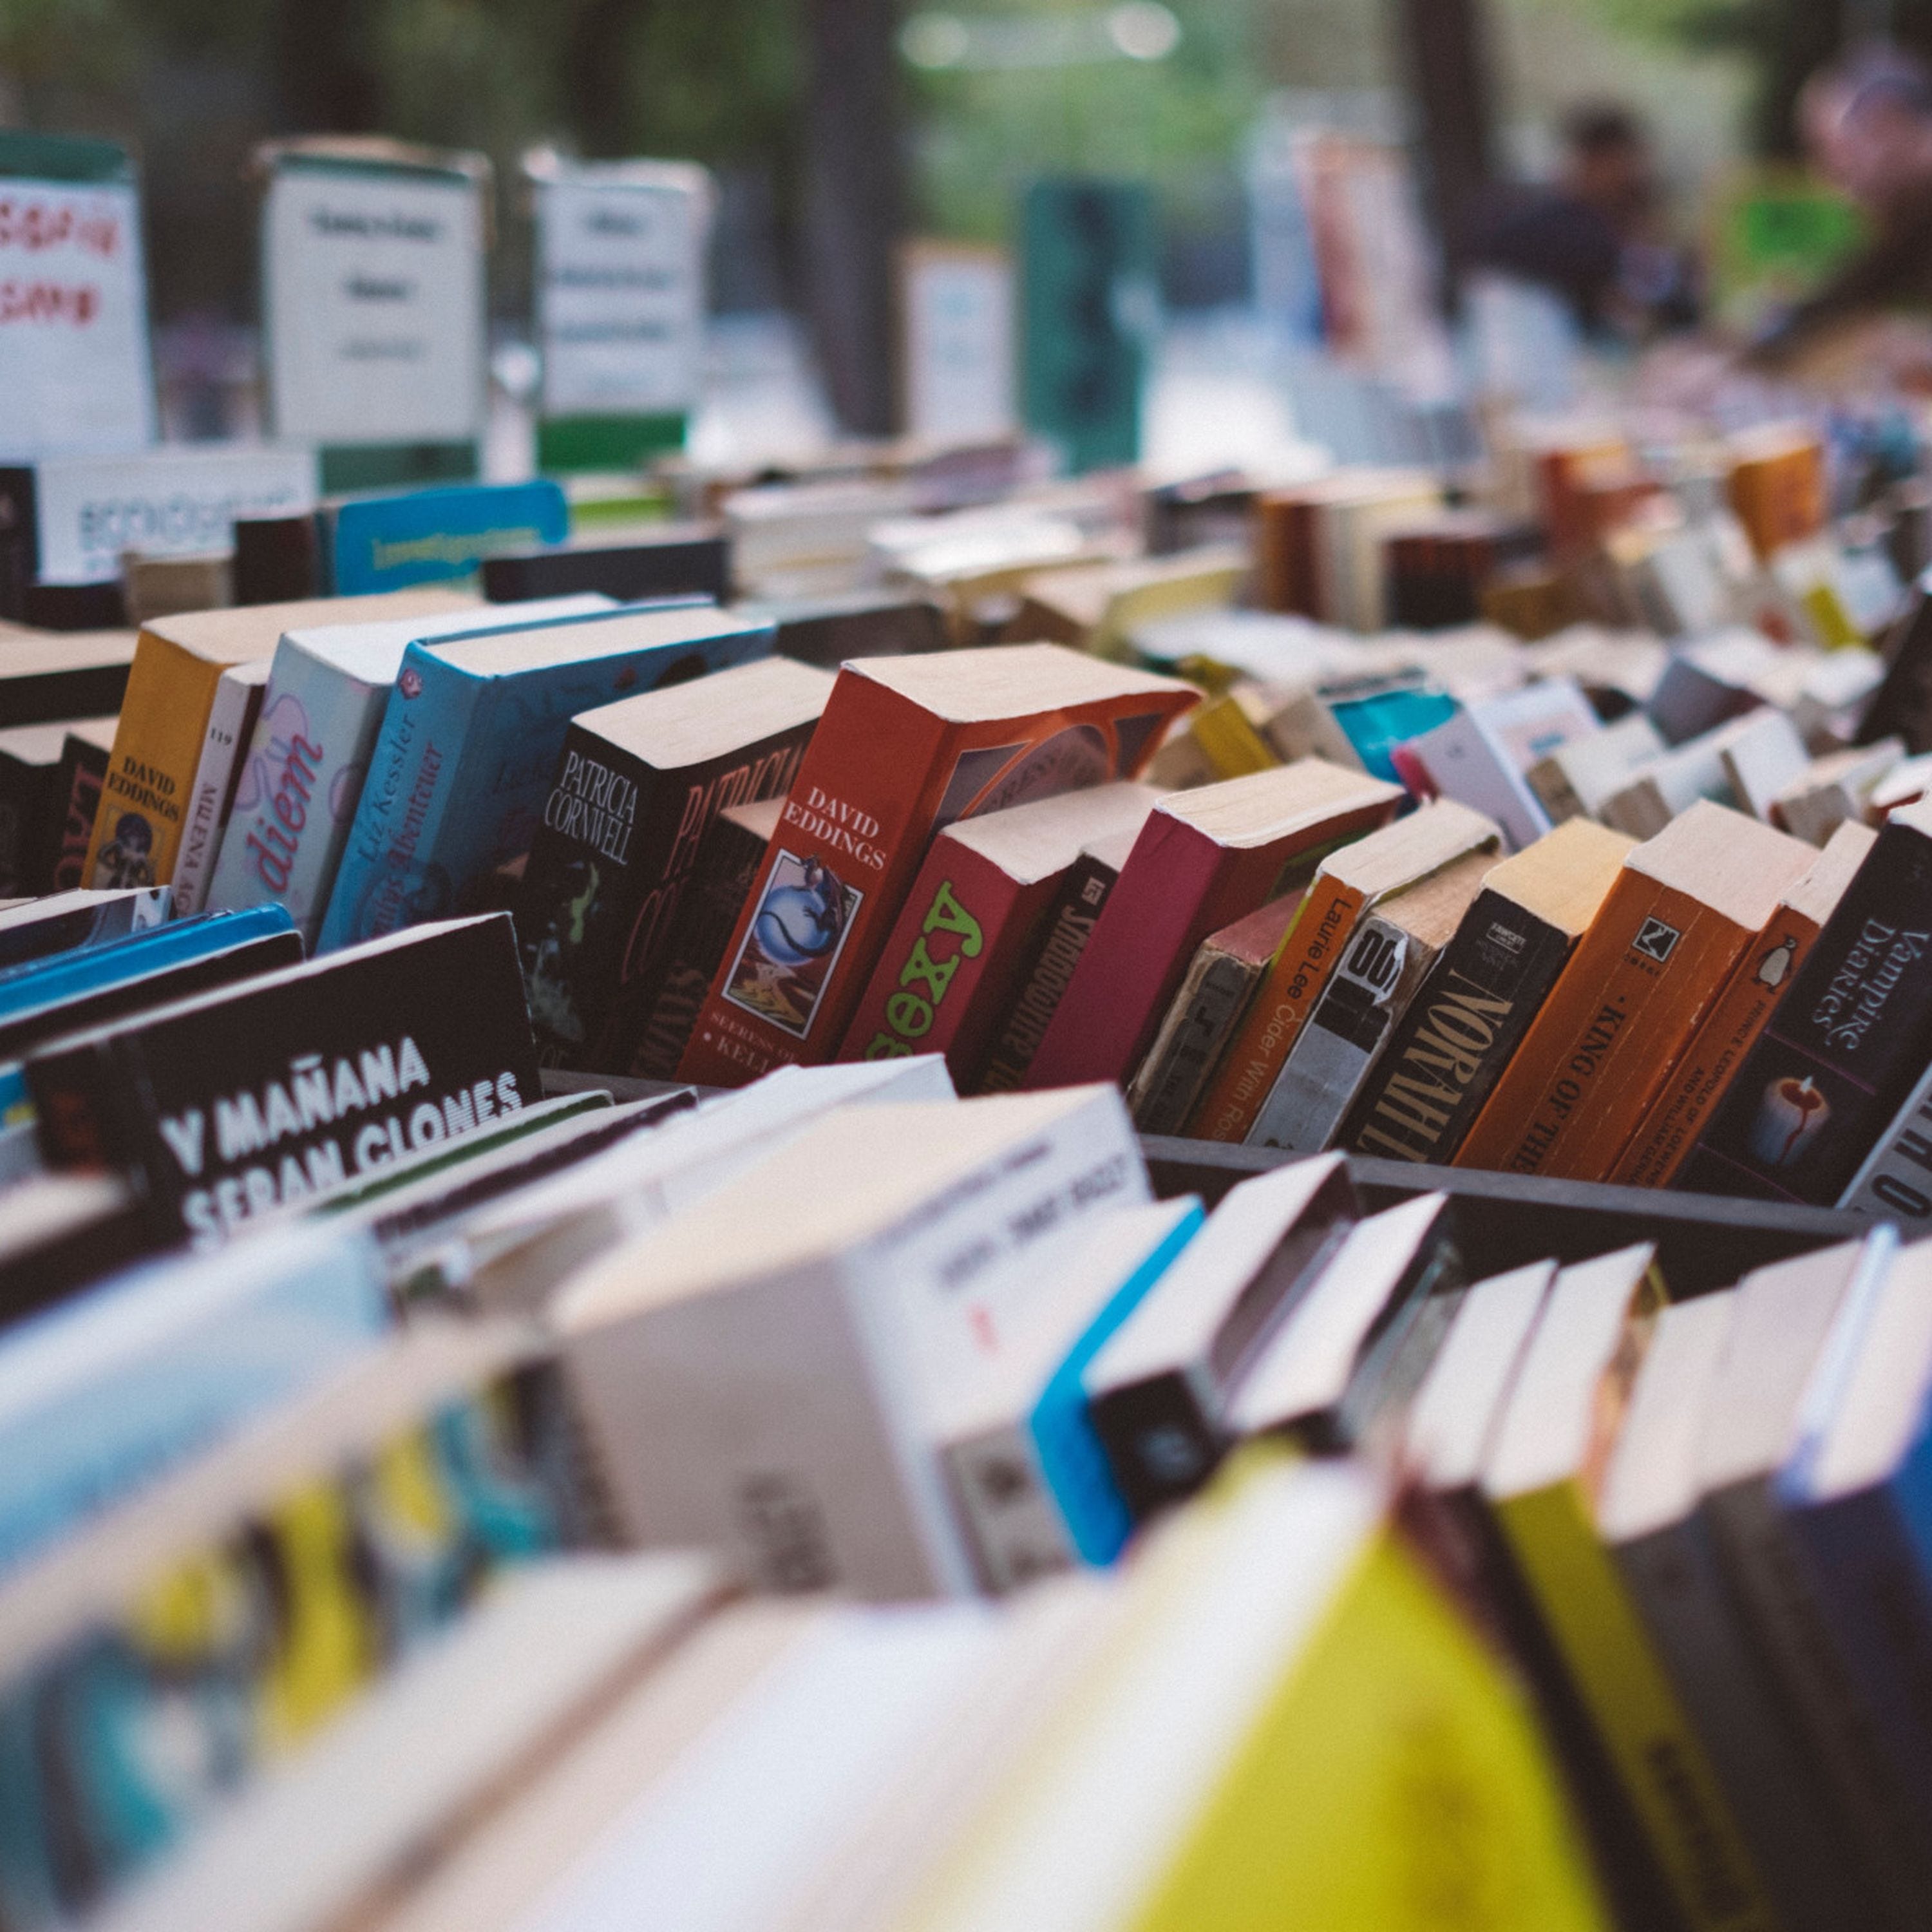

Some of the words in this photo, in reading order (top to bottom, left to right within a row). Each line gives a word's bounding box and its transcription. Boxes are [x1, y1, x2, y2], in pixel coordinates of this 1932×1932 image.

[108, 773, 179, 822] EDDINGS
[123, 756, 175, 796] DAVID
[371, 712, 417, 818] Kessler
[560, 750, 638, 824] PATRICIA
[246, 734, 323, 894] dien
[545, 788, 632, 866] CORNWELL
[783, 801, 887, 871] EDDINGS
[807, 786, 880, 838] DAVID
[1308, 897, 1352, 961] Laurie
[1287, 961, 1320, 1000] Lee
[1260, 1004, 1296, 1058] Cider
[1374, 969, 1514, 1144] NORAH
[1569, 1005, 1626, 1077] KING
[215, 1036, 430, 1161] MAÑANA
[1235, 1057, 1270, 1102] With
[1548, 1079, 1582, 1121] OF
[354, 1070, 524, 1174] CLONES
